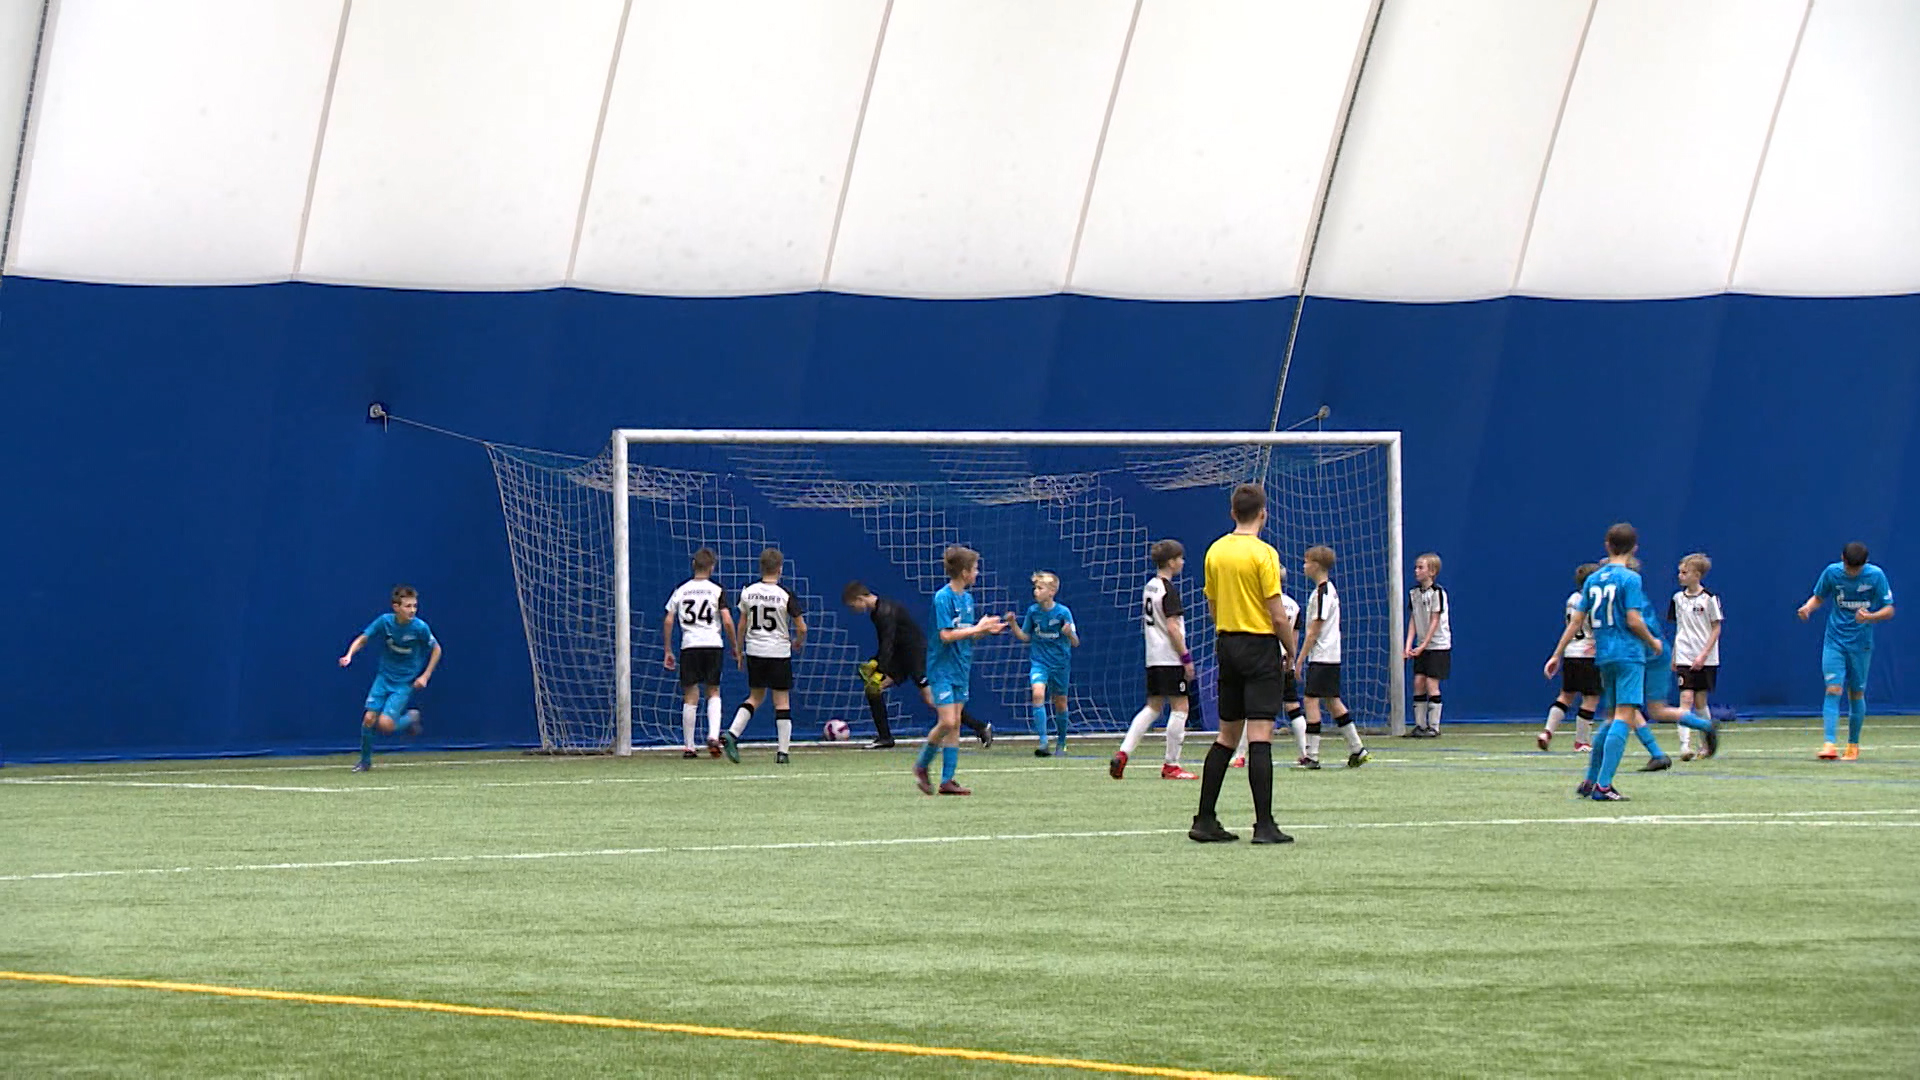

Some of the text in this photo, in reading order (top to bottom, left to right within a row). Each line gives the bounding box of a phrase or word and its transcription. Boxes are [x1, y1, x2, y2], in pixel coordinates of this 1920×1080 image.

[682, 599, 713, 624] 34
[750, 605, 777, 632] 15
[1145, 597, 1155, 626] 9
[1589, 583, 1617, 628] 27
